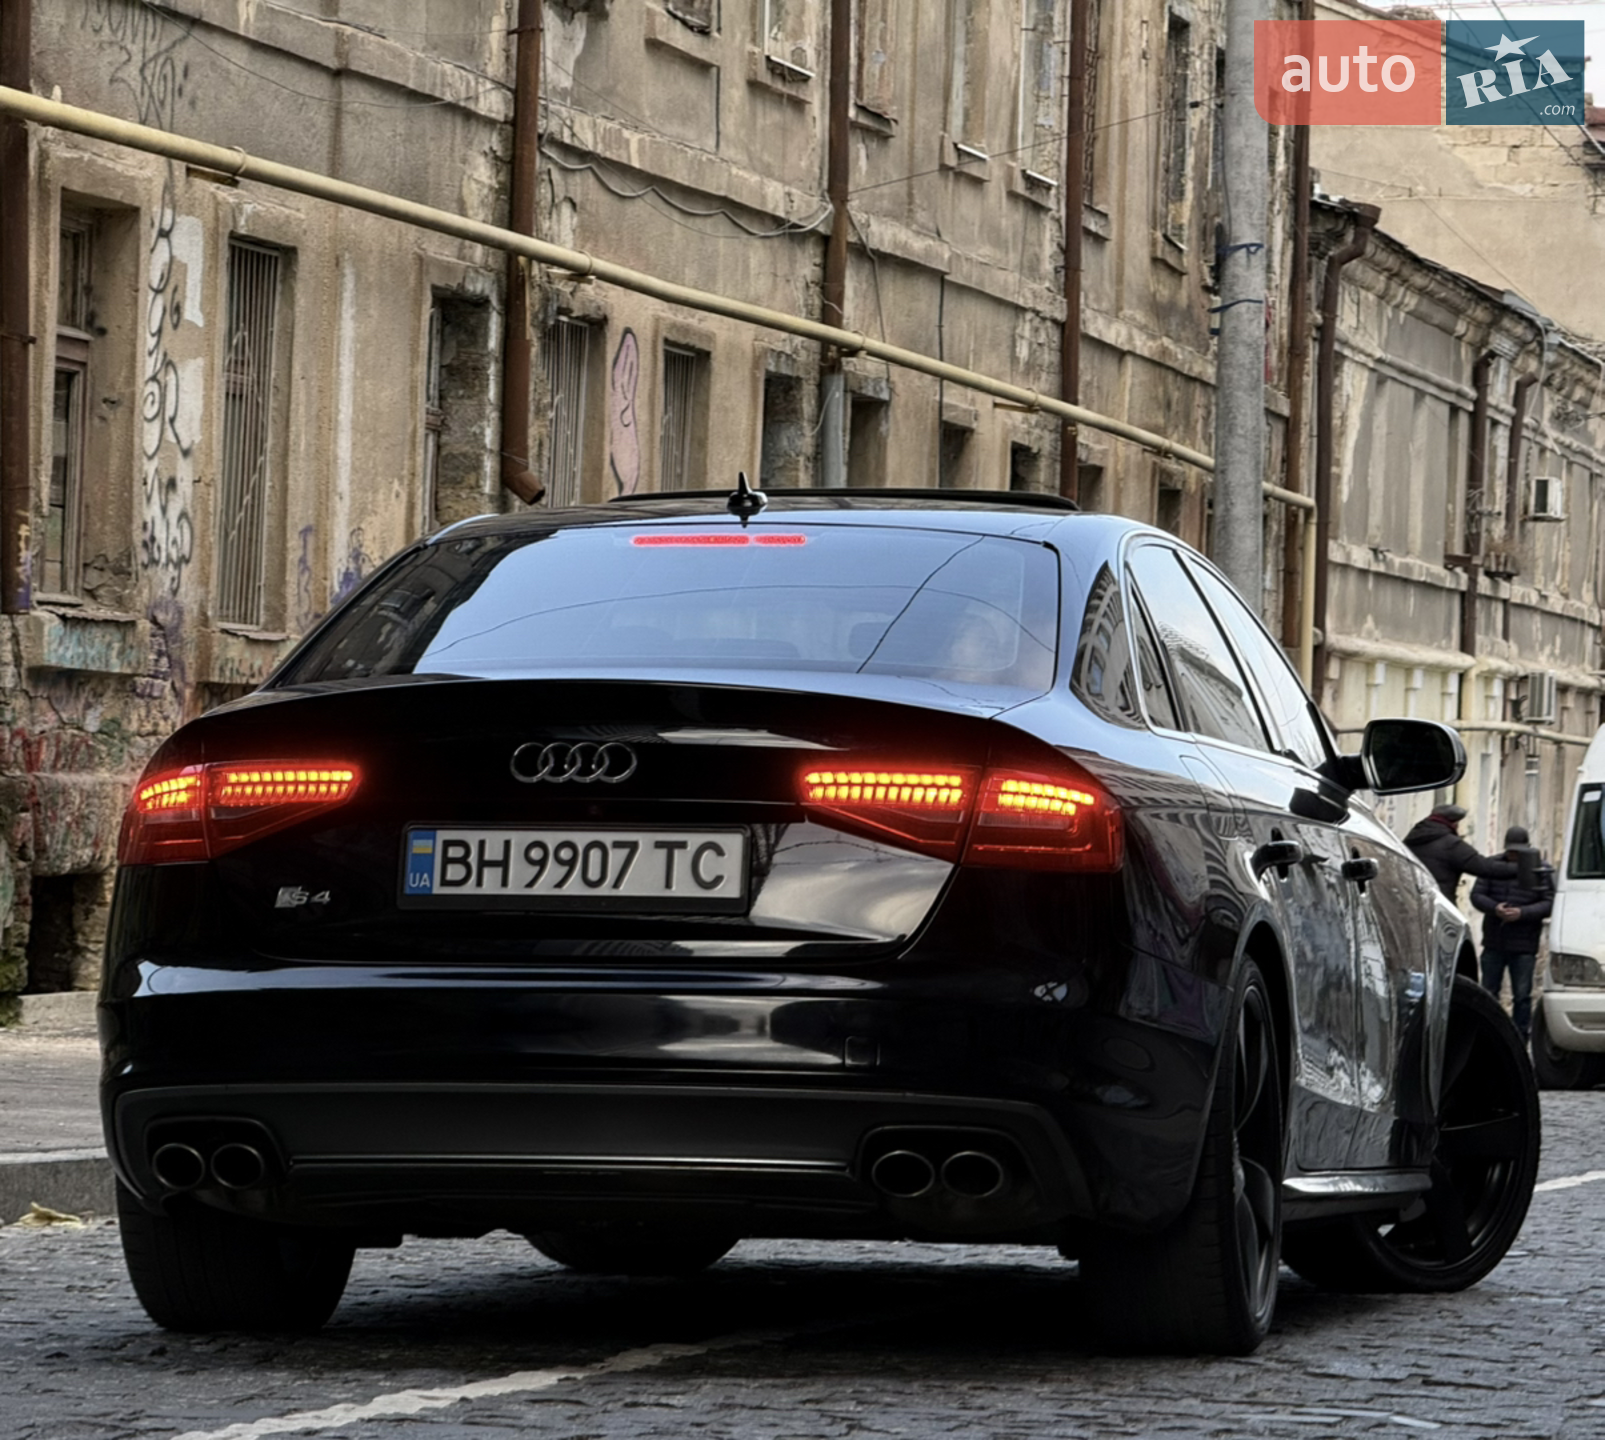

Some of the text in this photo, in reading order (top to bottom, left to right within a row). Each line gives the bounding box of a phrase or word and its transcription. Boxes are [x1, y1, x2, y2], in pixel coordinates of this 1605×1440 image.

[409, 873, 431, 888] UA
[440, 839, 726, 890] BH 9907 TC
